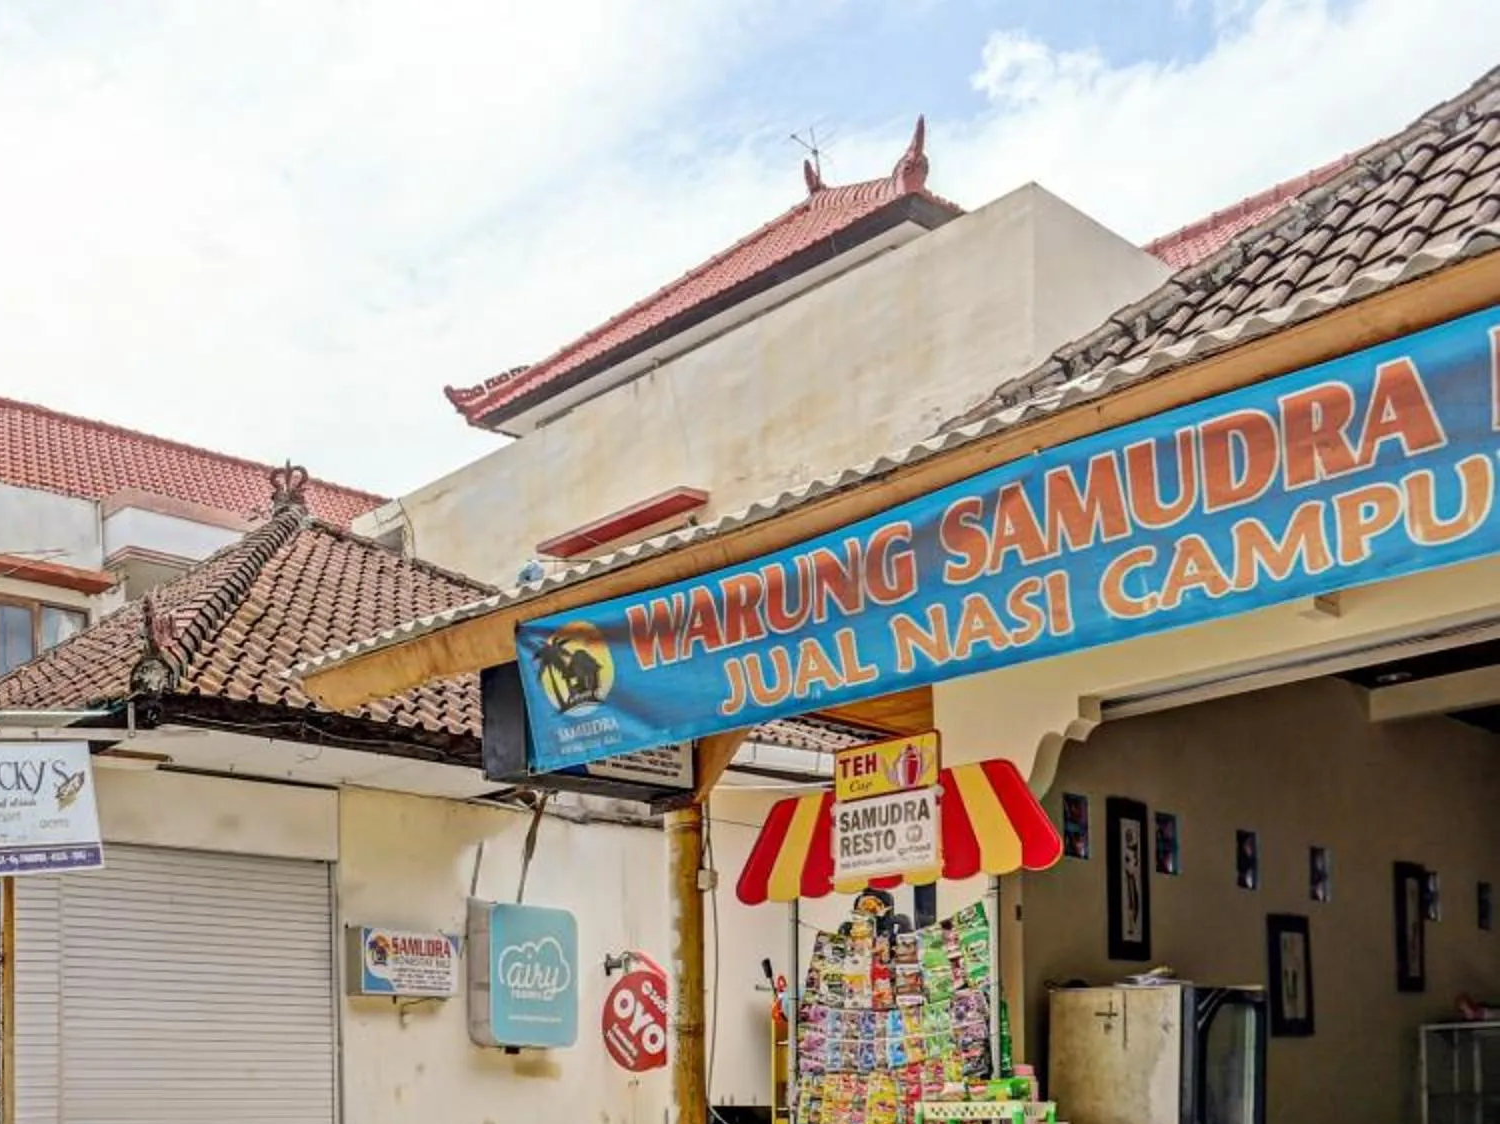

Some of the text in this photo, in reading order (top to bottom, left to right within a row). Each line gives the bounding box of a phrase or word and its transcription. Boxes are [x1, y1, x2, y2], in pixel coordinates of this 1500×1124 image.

[626, 520, 918, 670] WARUNG
[940, 356, 1447, 585] SAMUDRA
[719, 454, 1500, 715] JUAL NASI CAMPU
[838, 752, 877, 779] TEH
[839, 797, 930, 833] SAMUDRA
[840, 828, 896, 858] RESTO
[506, 951, 559, 1000] airy
[613, 989, 665, 1055] OYO
